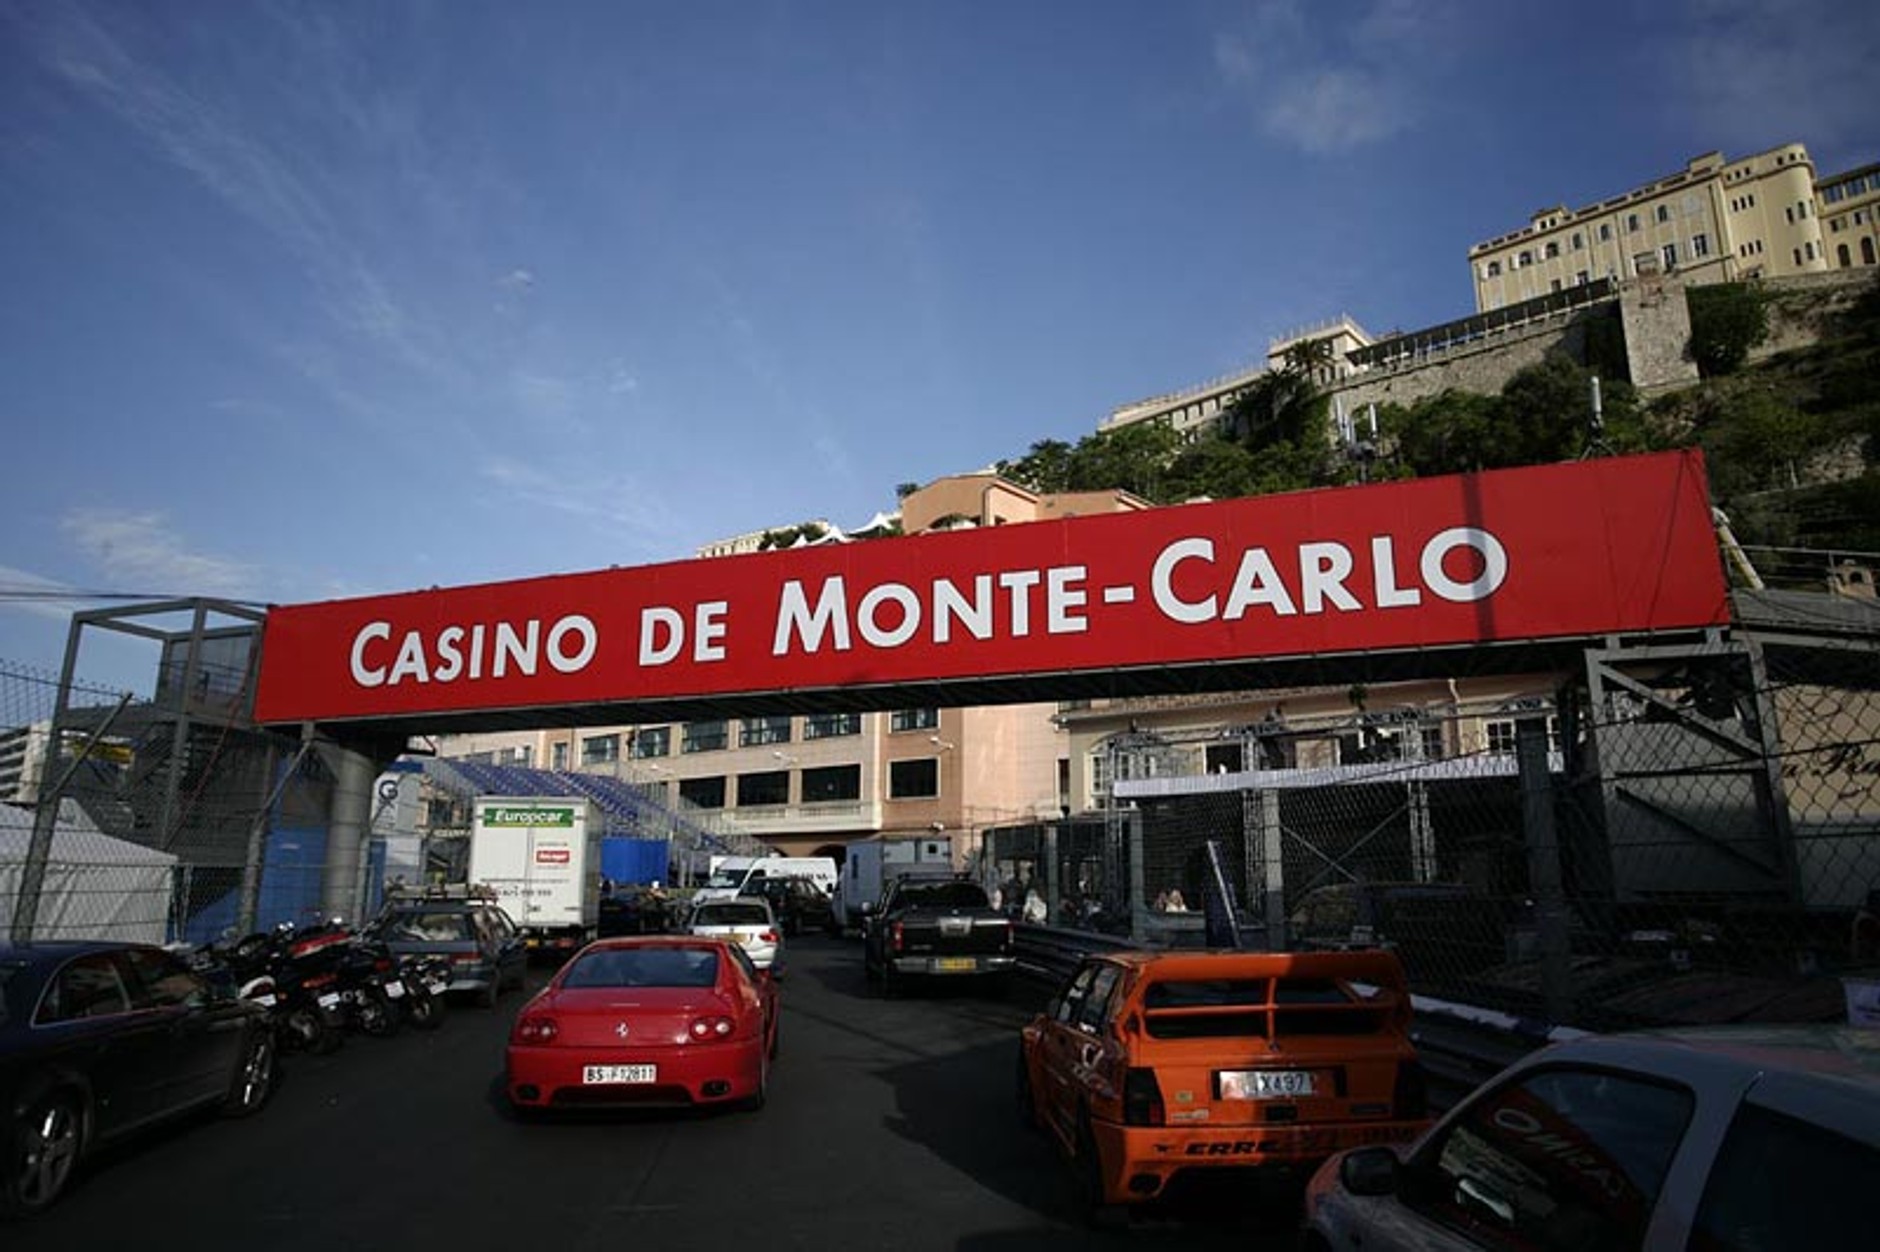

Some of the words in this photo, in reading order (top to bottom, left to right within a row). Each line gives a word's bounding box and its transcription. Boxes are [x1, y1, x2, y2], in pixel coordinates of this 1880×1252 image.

[350, 614, 598, 687] CASINO
[638, 601, 728, 667] DE
[494, 808, 563, 824] Europcar
